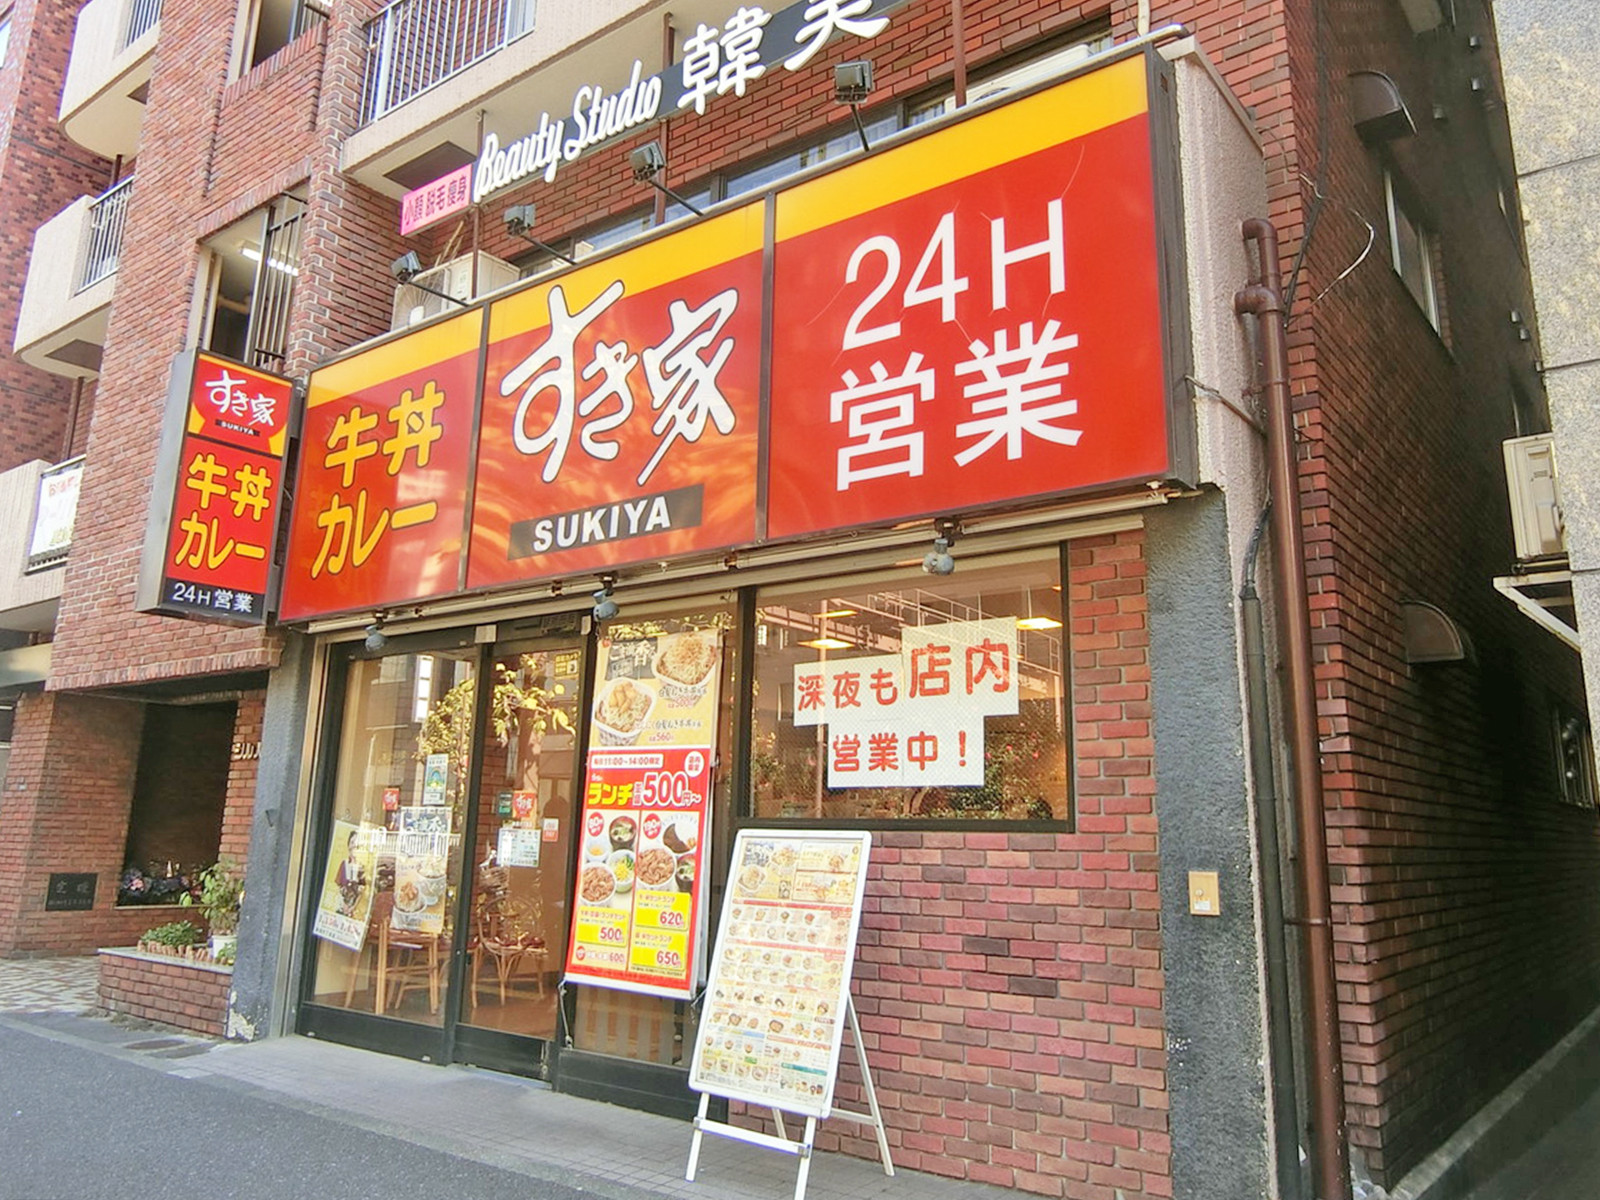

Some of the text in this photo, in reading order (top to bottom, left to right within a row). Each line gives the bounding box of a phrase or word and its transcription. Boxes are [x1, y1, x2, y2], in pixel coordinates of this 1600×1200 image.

[473, 112, 564, 203] Beauty
[564, 60, 662, 161] Studio
[843, 198, 1065, 350] 24H
[205, 369, 276, 427] すき家
[500, 279, 738, 486] すき家
[830, 319, 1083, 491] 営業
[221, 421, 254, 435] SUKIYA
[324, 380, 445, 488] 牛丼
[186, 454, 272, 521] 牛丼
[532, 496, 672, 553] SUKIYA
[175, 511, 265, 570] カレー
[310, 489, 438, 580] カレー
[797, 637, 1011, 711] 深夜も店内
[588, 783, 633, 805] ランチ
